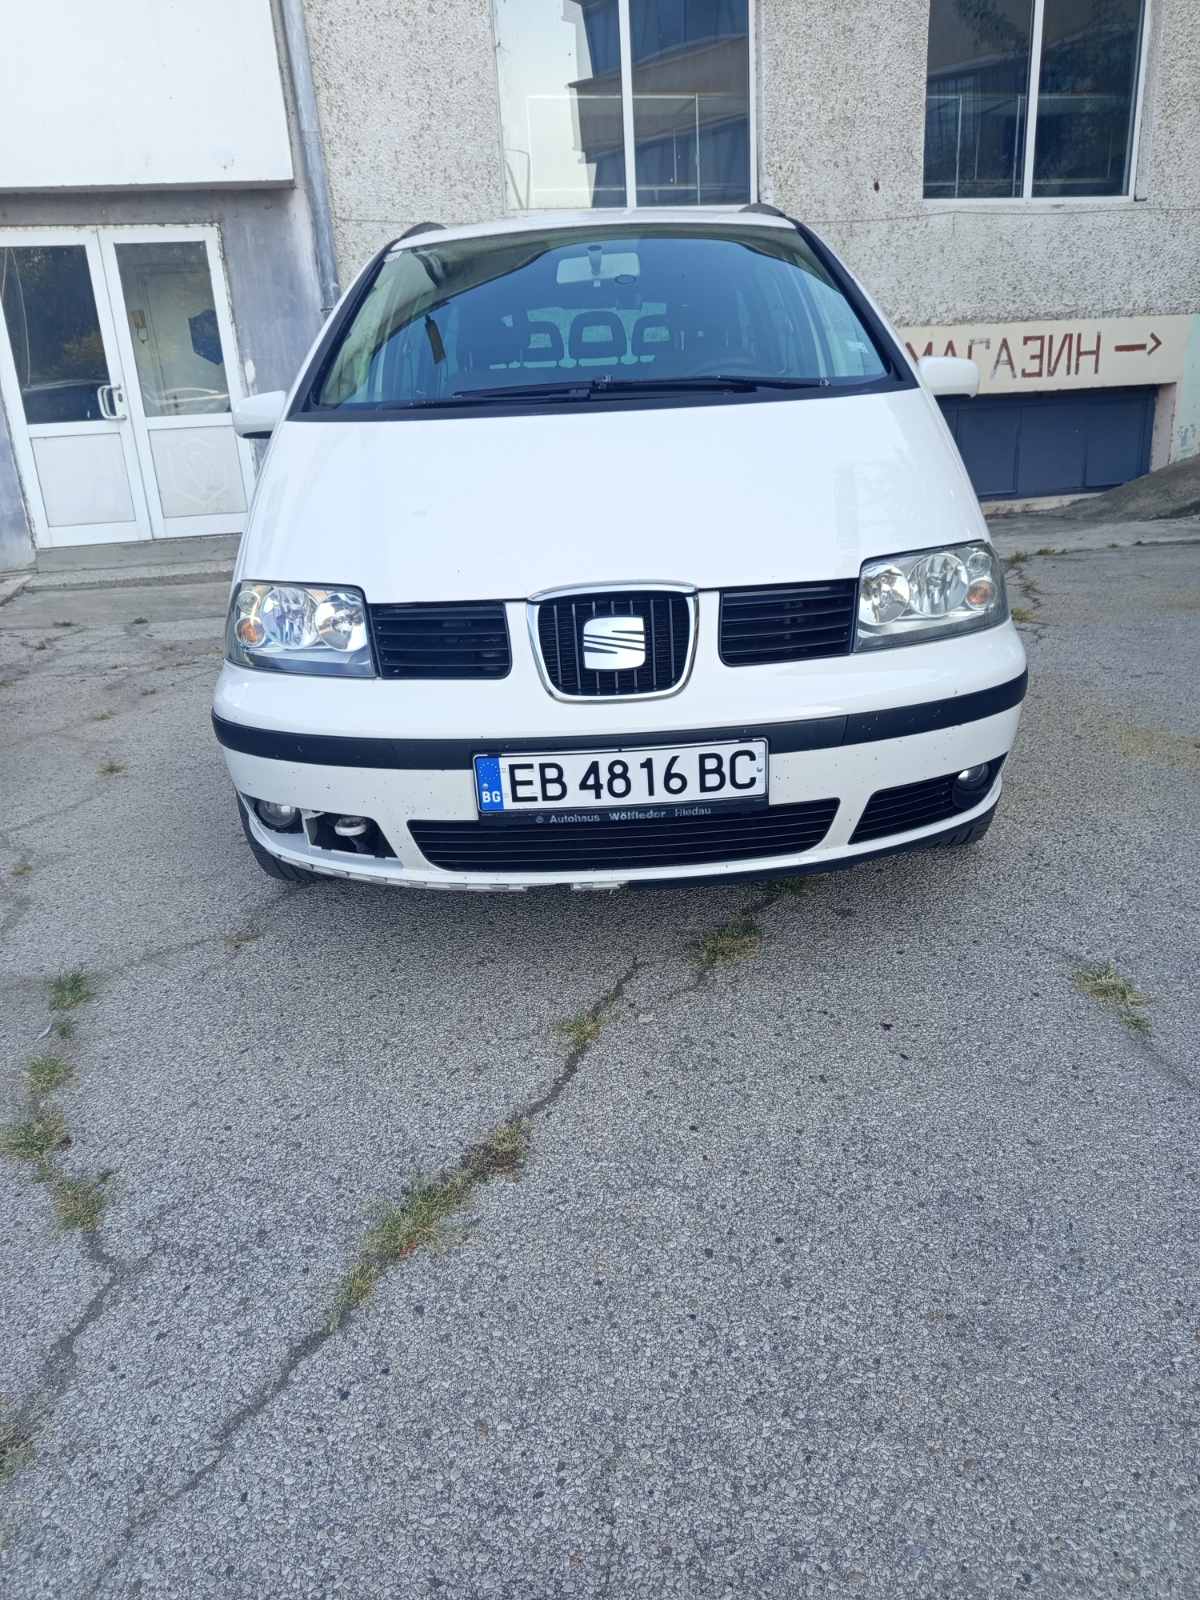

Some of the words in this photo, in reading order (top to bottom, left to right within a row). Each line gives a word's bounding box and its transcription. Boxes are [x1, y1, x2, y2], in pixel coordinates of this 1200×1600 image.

[508, 762, 567, 802] EB
[579, 755, 688, 799] 4816
[698, 749, 757, 793] BC
[482, 791, 501, 803] BG
[550, 813, 601, 824] Autohaus
